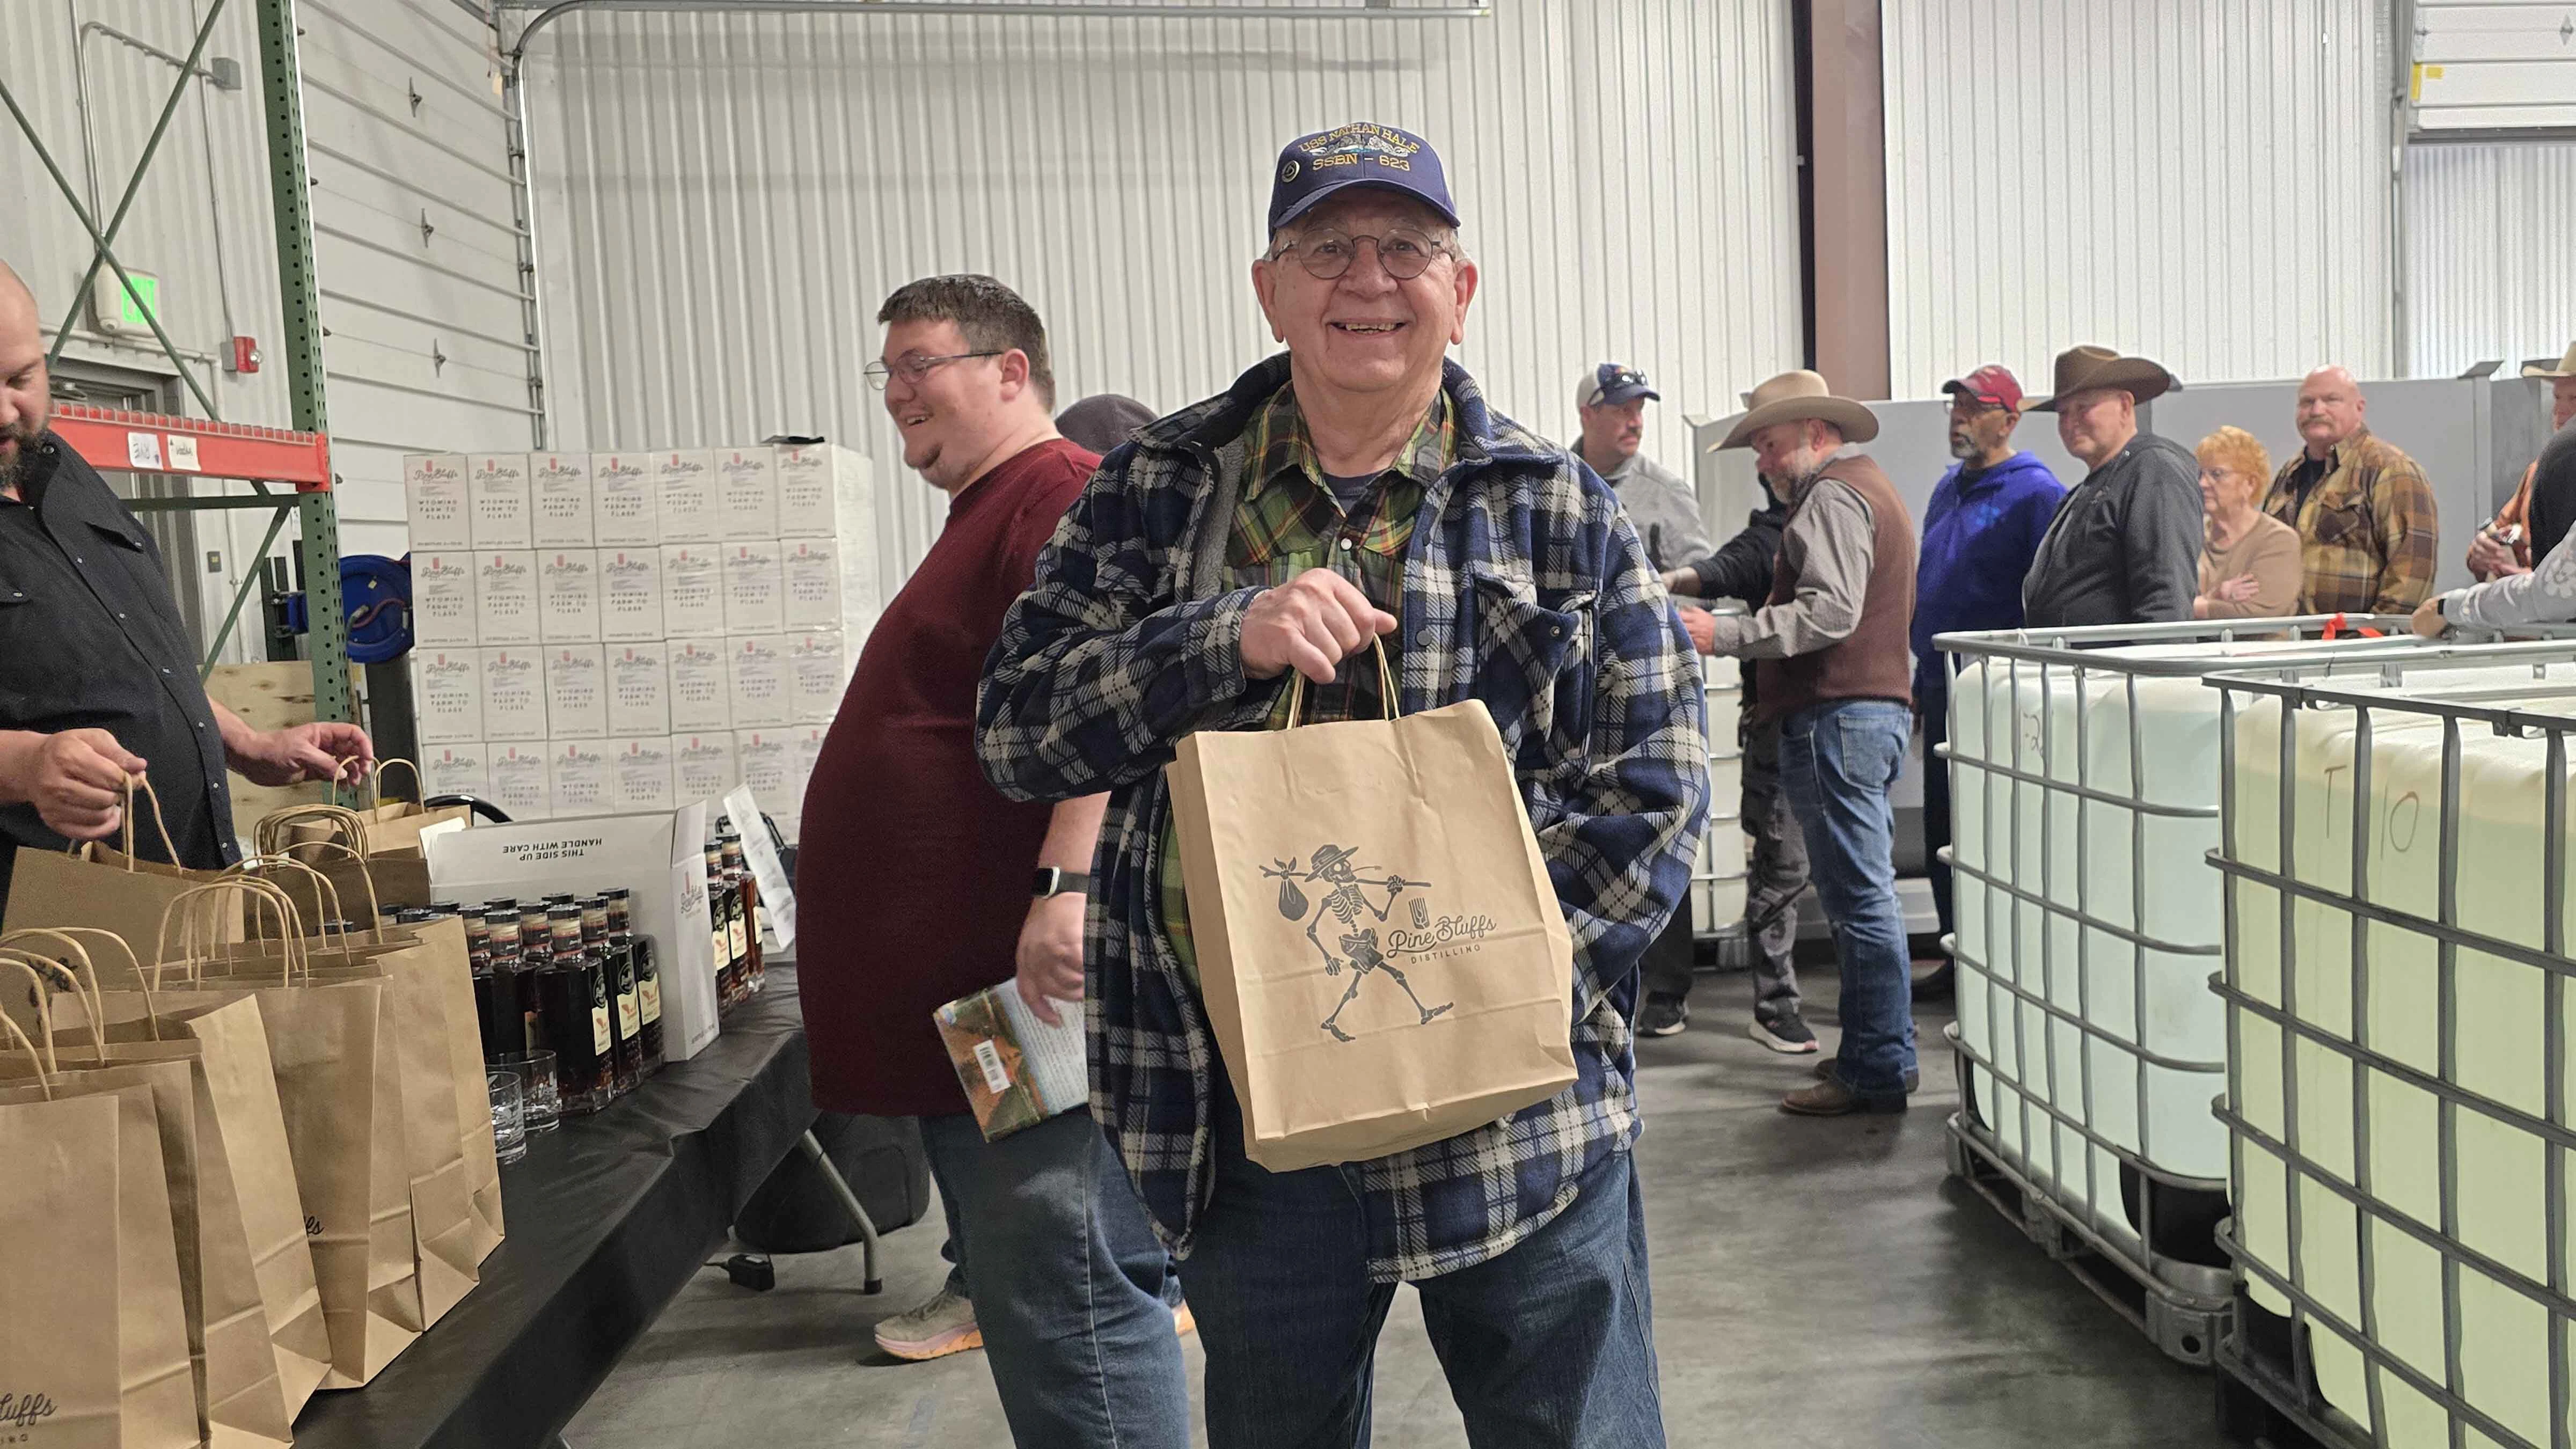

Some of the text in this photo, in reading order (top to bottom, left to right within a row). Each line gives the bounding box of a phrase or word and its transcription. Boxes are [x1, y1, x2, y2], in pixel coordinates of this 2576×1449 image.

[1298, 123, 1420, 154] USS NATHAN HALE
[1312, 153, 1358, 171] SSBN
[1379, 155, 1410, 172] 623
[2324, 764, 2419, 861] T 10
[502, 838, 602, 853] HANDLE WITH CARE
[535, 851, 558, 860] SIDE
[562, 848, 584, 858] THIS
[1386, 914, 1496, 958] Pine Bluffs
[1411, 944, 1481, 964] DISTILLING
[0, 1393, 58, 1426] luffs
